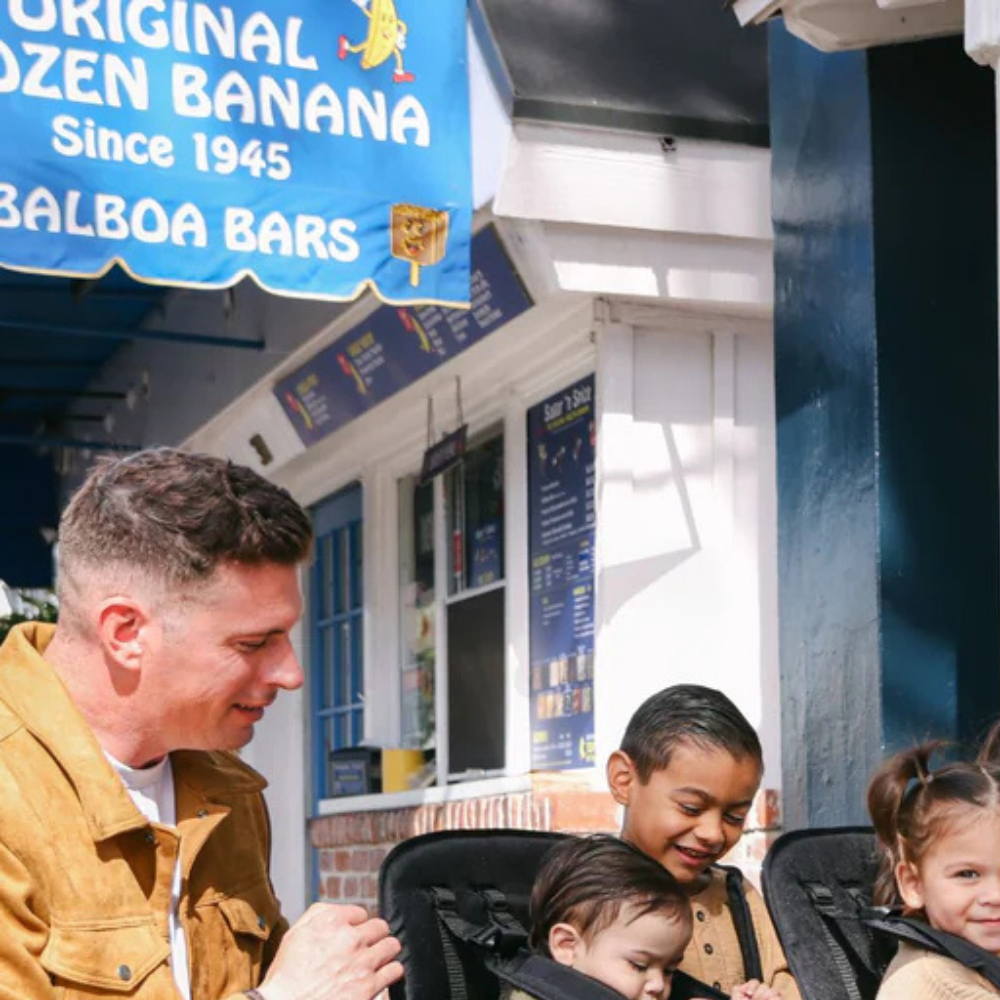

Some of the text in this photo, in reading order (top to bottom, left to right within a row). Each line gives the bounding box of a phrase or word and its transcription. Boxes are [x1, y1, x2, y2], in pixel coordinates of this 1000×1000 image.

[8, 0, 319, 71] ORIGINAL
[171, 62, 431, 148] BANANA
[52, 114, 292, 181] Since 1945
[0, 182, 361, 262] BALBOA BARS
